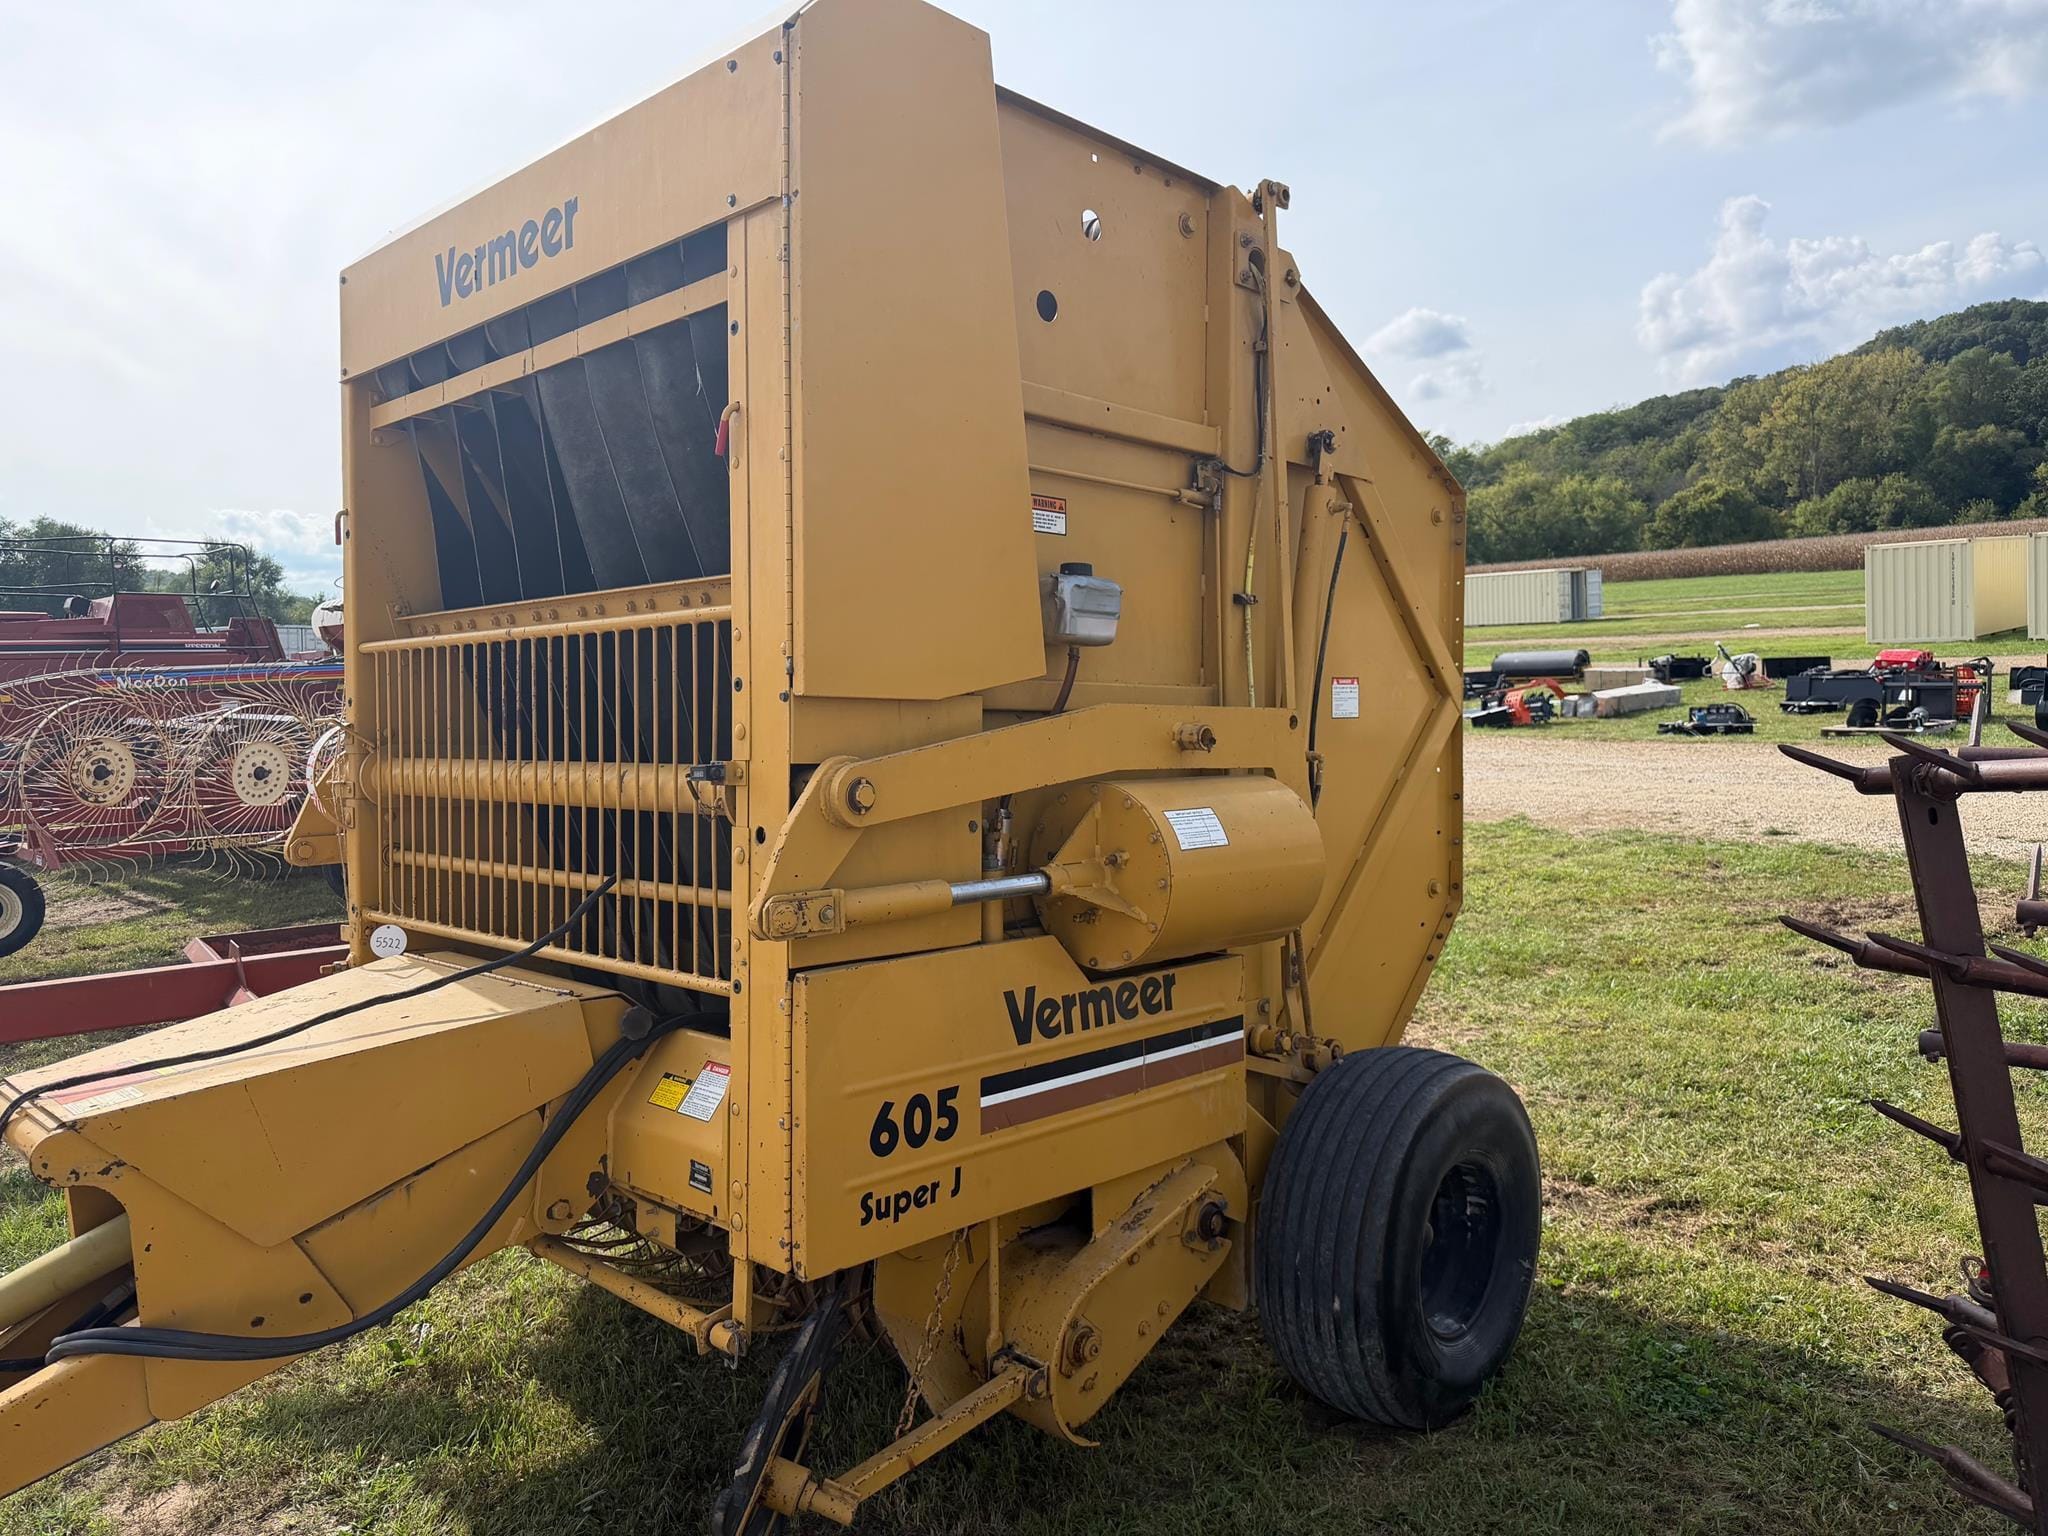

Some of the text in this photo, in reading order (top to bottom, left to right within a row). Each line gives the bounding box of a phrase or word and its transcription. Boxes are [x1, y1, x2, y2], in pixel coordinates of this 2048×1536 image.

[435, 196, 578, 308] Vermeer
[1033, 498, 1057, 510] WARNING
[116, 674, 189, 689] MacDon
[375, 936, 401, 950] 5522
[1003, 973, 1177, 1046] Vermeer
[869, 1085, 960, 1158] 605
[860, 1166, 962, 1227] Super J
